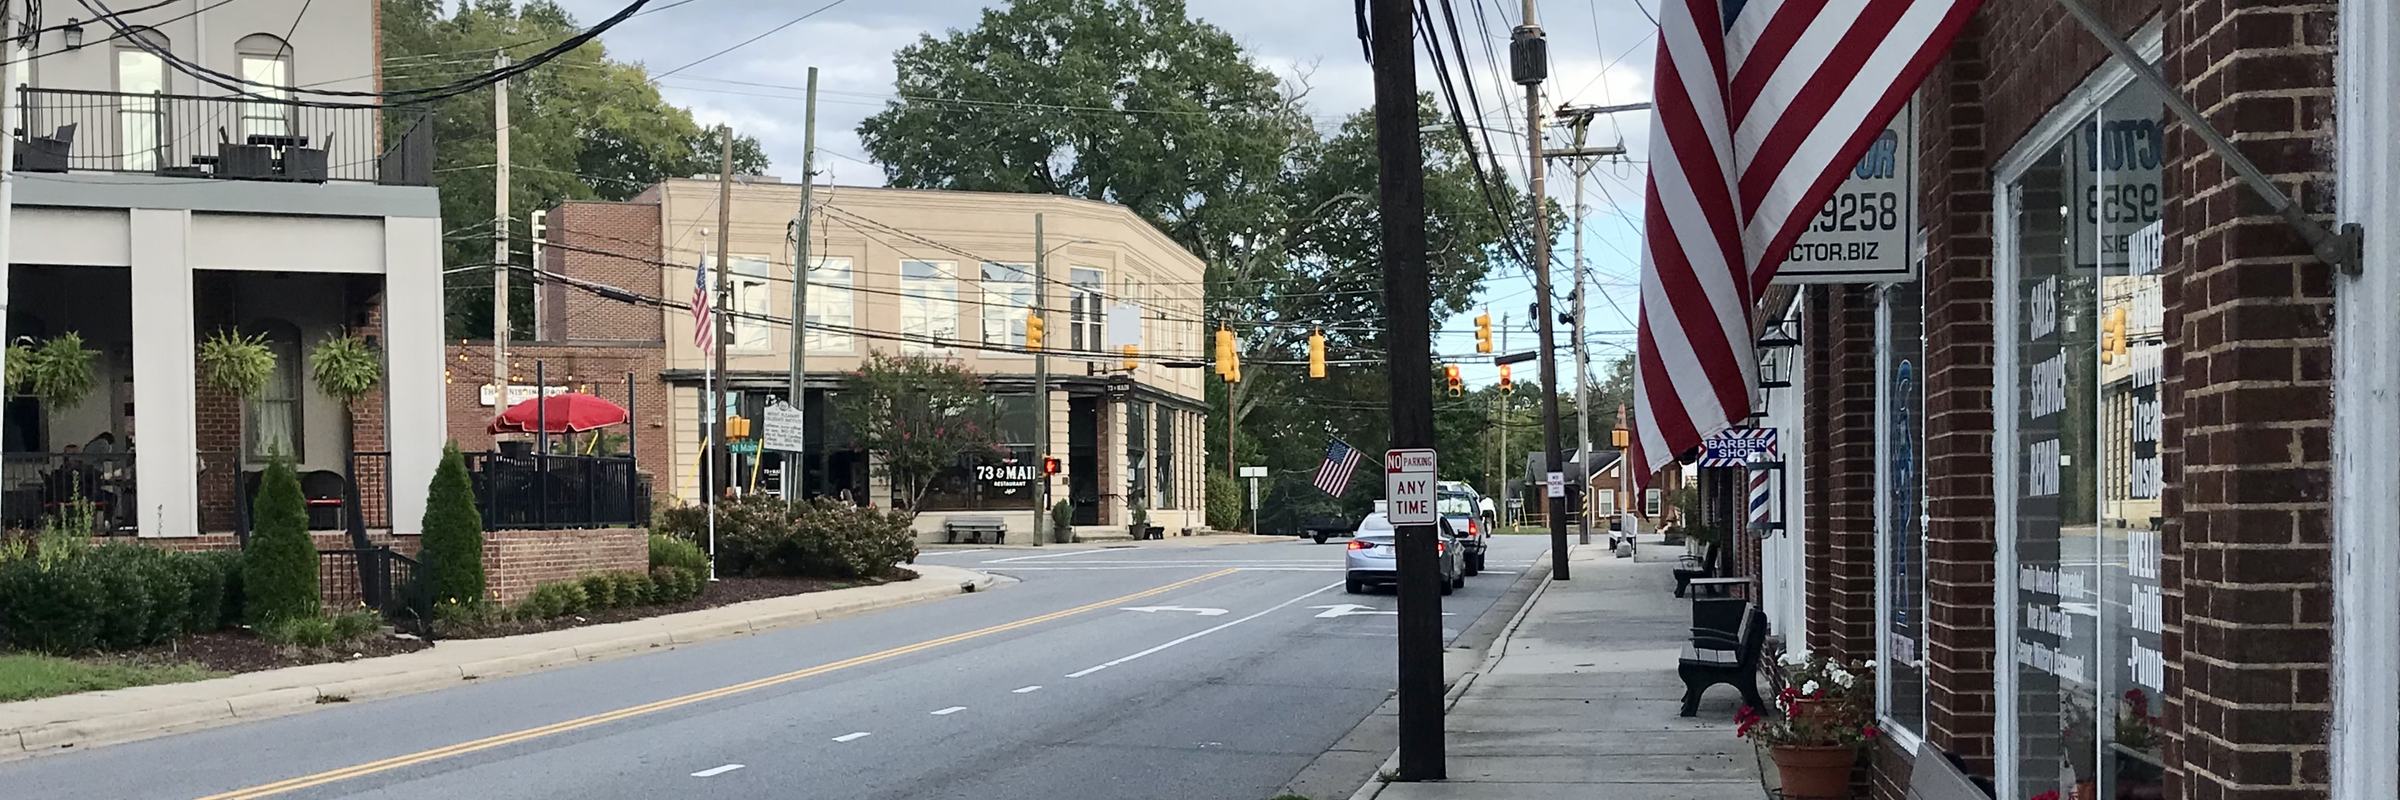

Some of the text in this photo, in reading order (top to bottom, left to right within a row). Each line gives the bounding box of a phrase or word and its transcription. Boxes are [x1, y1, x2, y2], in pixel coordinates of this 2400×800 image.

[2030, 274, 2056, 342] SALES
[2030, 351, 2067, 420] SERVICE
[1708, 439, 1766, 449] BARBER
[1387, 455, 1432, 469] NO PARKING
[2029, 438, 2060, 497] REPAIR
[977, 465, 1036, 480] 73 & MAI
[1397, 480, 1426, 495] ANY
[1396, 500, 1428, 515] TIME
[2128, 531, 2156, 579] WELL
